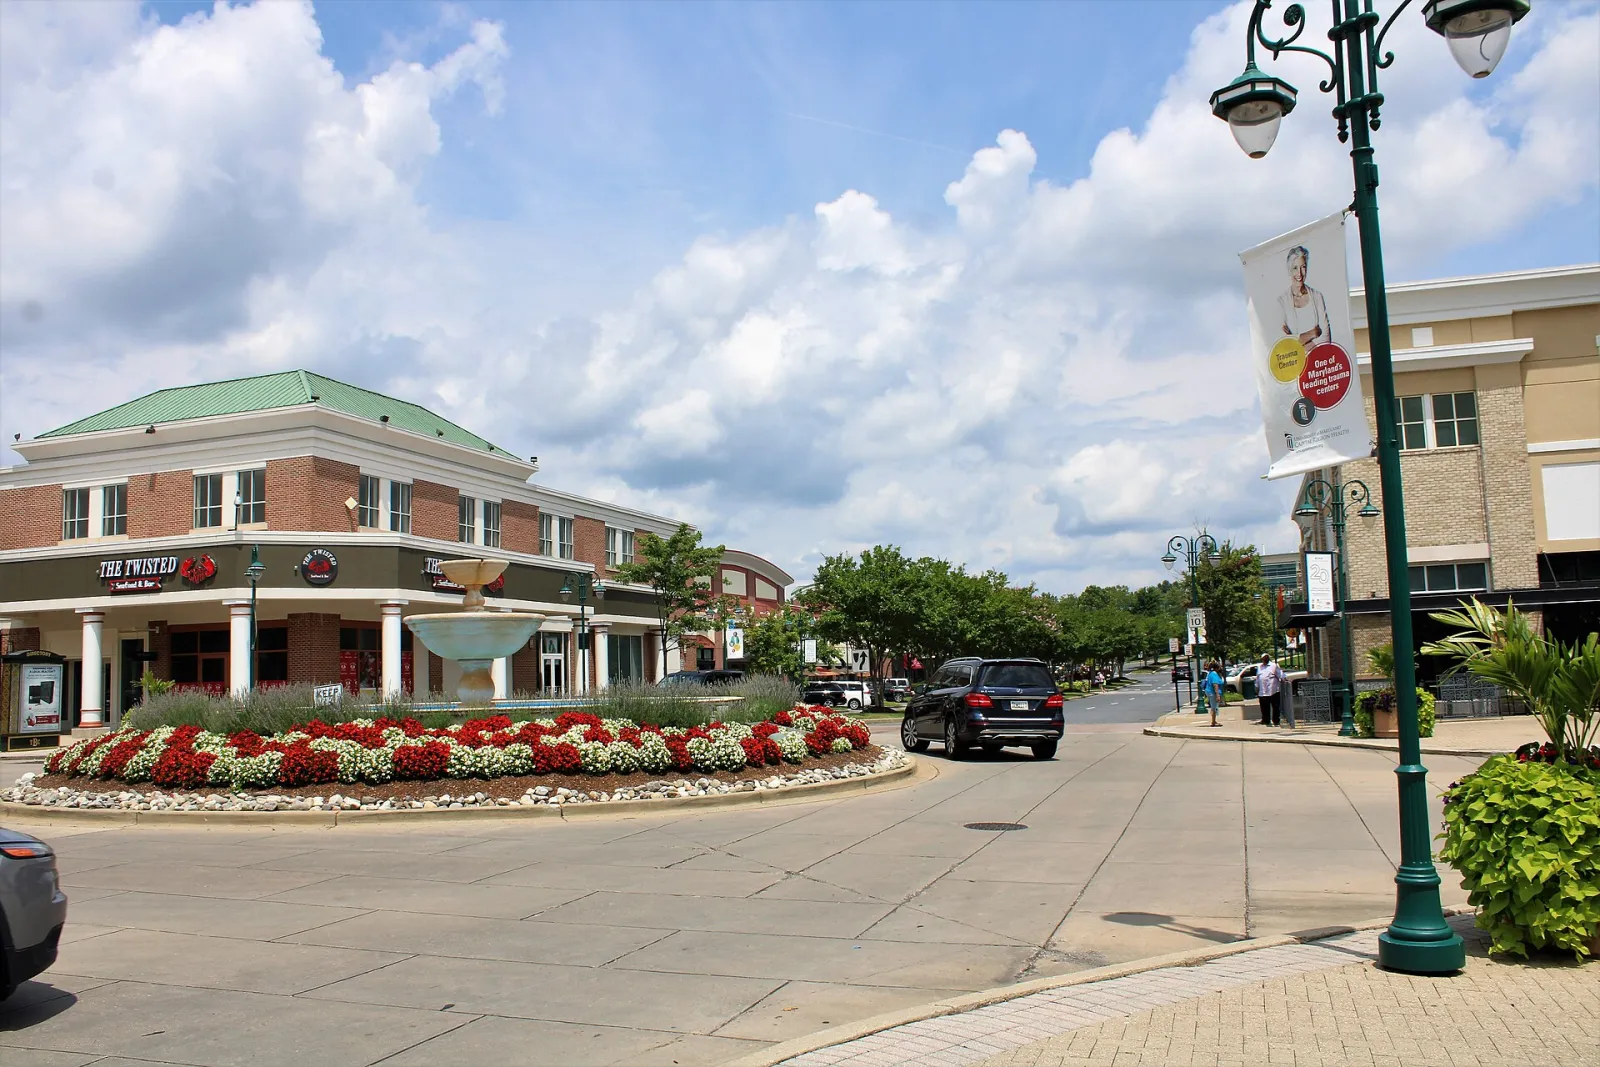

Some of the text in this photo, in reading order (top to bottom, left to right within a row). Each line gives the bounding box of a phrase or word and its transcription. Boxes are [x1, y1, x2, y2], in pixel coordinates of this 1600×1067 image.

[1276, 350, 1298, 361] Trauma
[1314, 354, 1336, 369] One of
[1278, 359, 1298, 369] Center
[1307, 362, 1343, 379] Maryland's
[1302, 370, 1350, 390] leading trauma
[1316, 383, 1340, 395] centers
[302, 548, 338, 566] THE TWISTED
[100, 556, 179, 578] THE TWISTED
[1310, 563, 1330, 585] 20
[115, 580, 155, 590] Seafood & Bar
[1191, 618, 1201, 626] 10
[315, 688, 338, 700] KEEP
